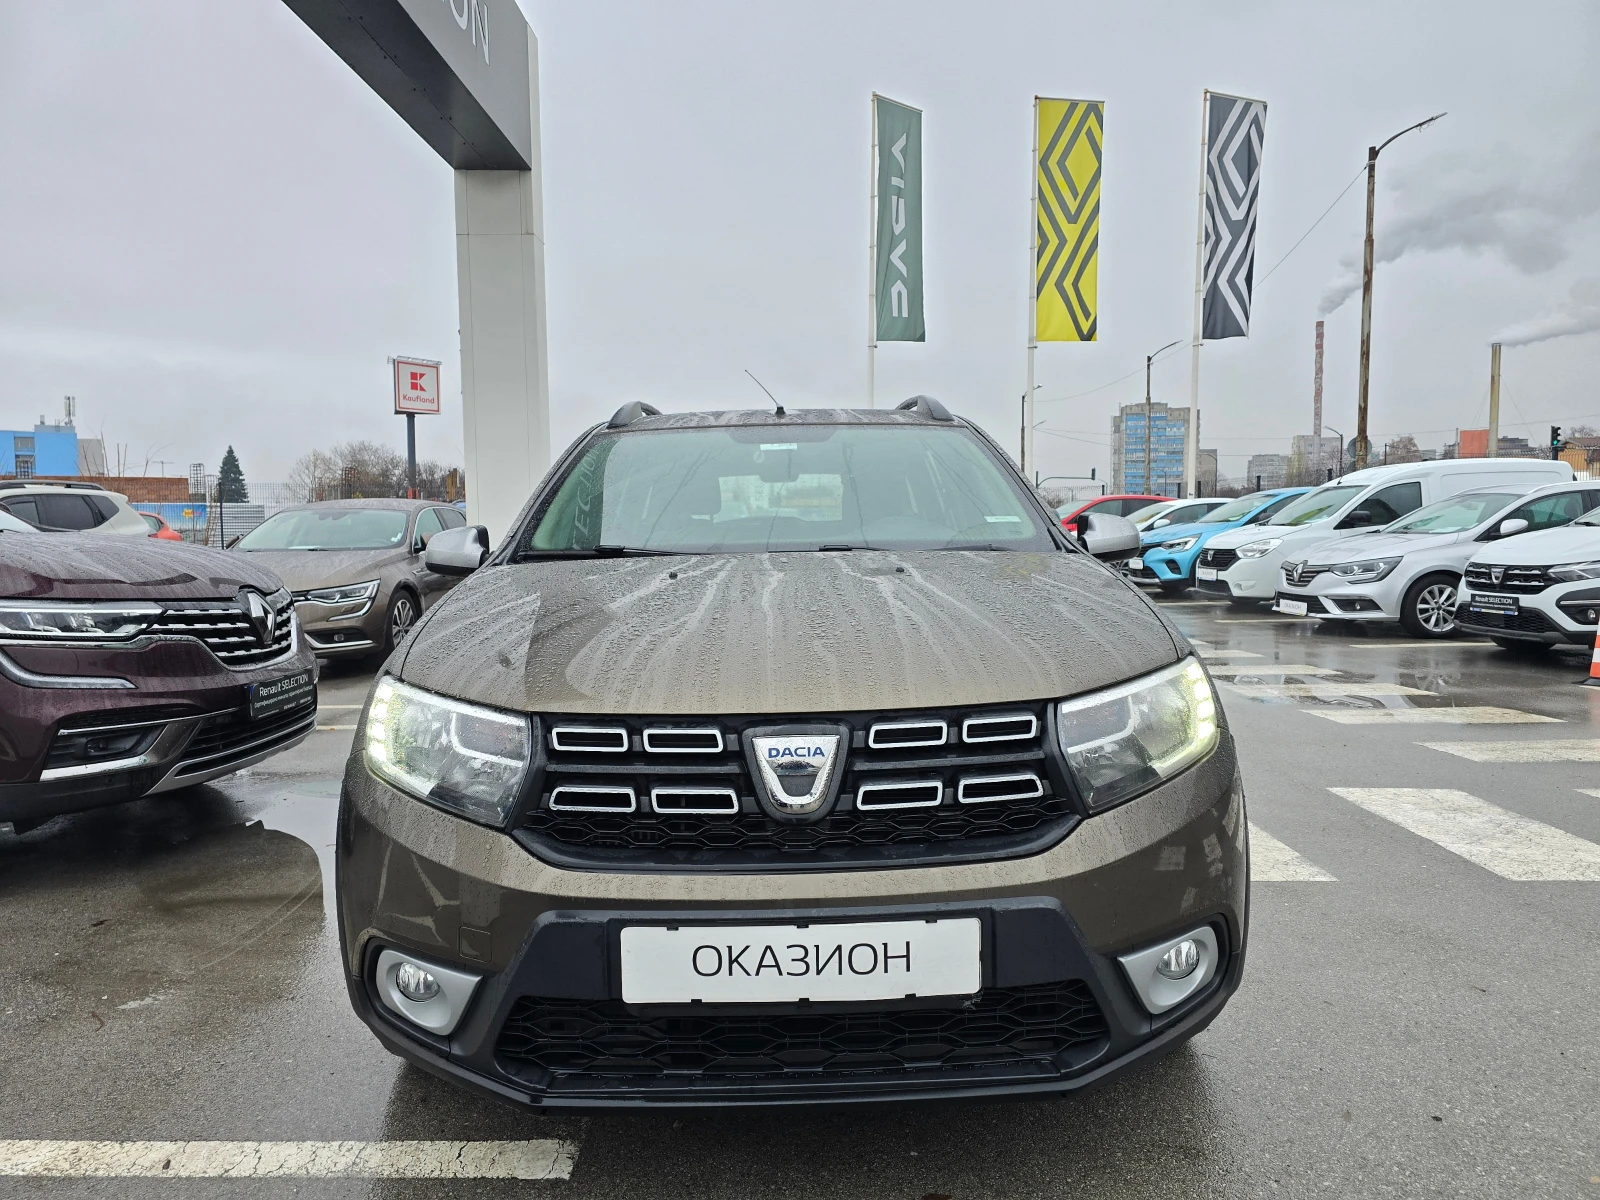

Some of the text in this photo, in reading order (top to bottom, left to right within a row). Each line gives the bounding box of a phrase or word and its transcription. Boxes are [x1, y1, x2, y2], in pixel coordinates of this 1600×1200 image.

[889, 132, 909, 318] DACIA
[402, 393, 435, 404] Kaufland
[259, 682, 281, 697] Renault
[281, 673, 309, 691] SELECTION
[768, 747, 825, 758] DACIA
[692, 941, 911, 977] ОКАЗИОН
